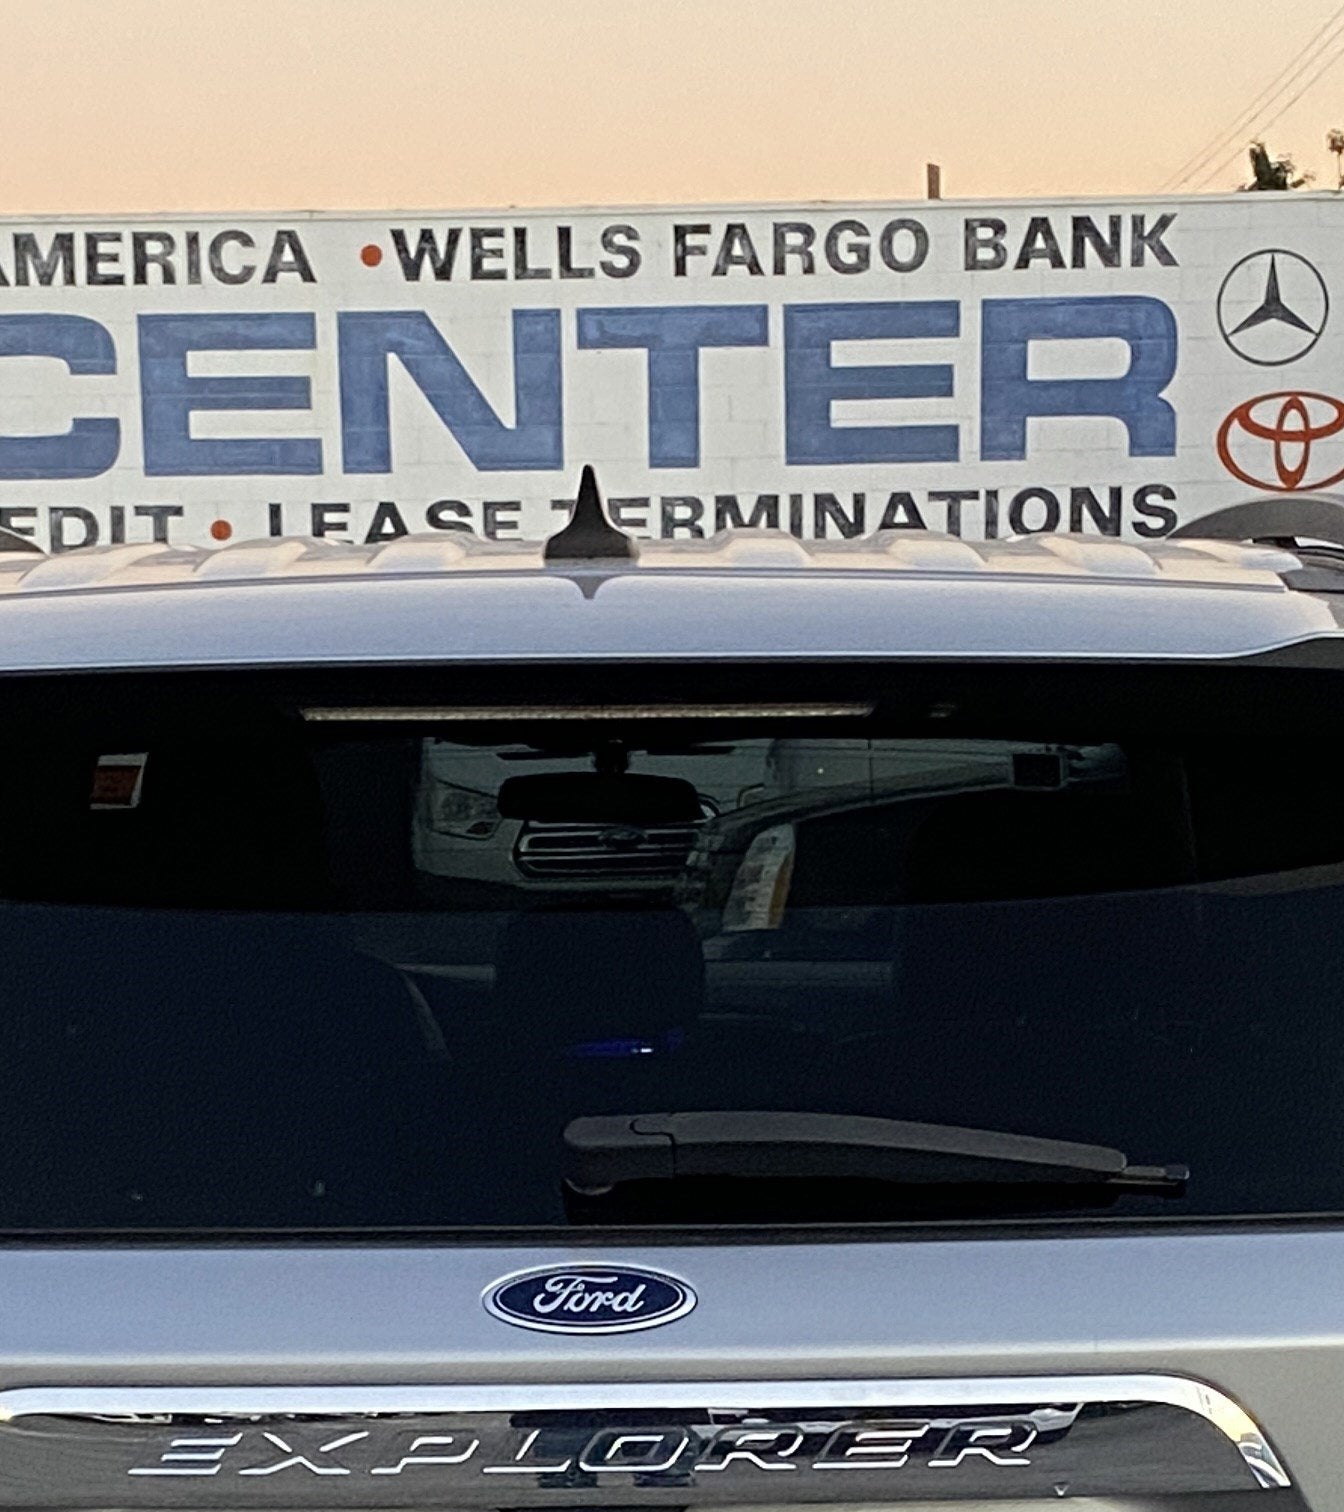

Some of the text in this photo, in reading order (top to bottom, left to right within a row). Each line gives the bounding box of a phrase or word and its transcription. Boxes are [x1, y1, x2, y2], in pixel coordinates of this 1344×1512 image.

[390, 212, 1179, 281] WELLS FARGO BANK
[533, 1275, 646, 1314] Ford
[127, 1420, 1037, 1476] EXPLORER
